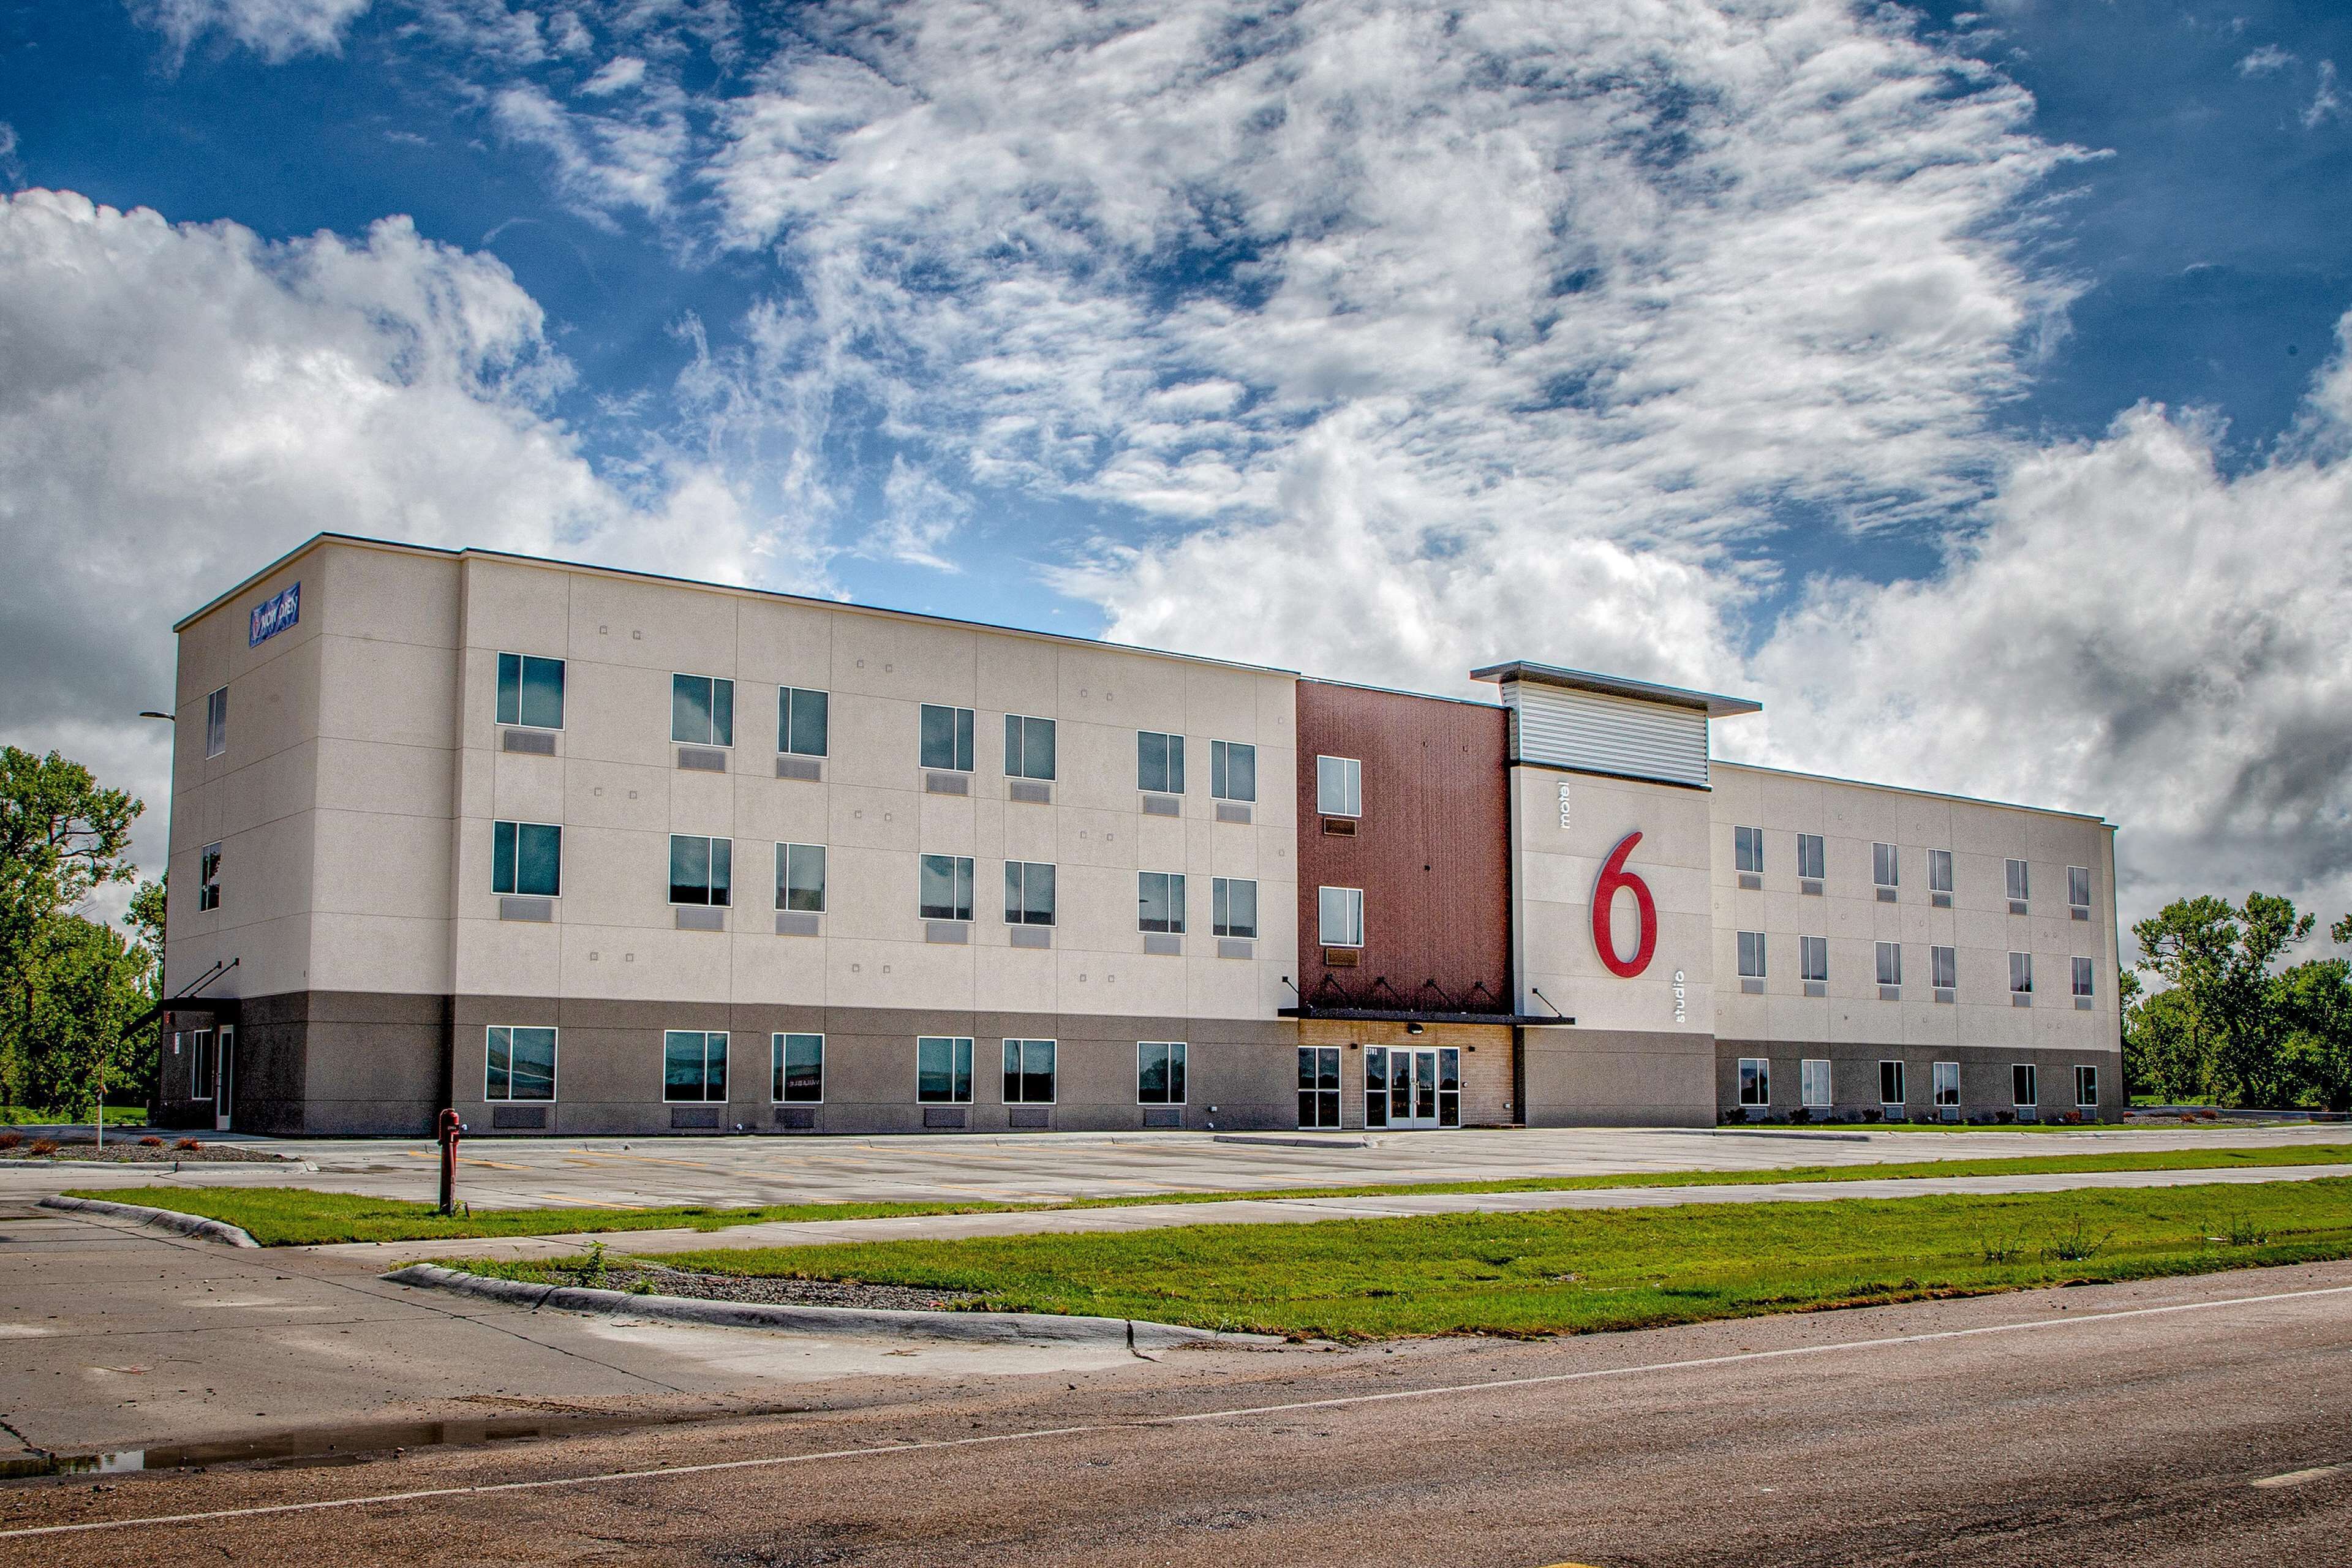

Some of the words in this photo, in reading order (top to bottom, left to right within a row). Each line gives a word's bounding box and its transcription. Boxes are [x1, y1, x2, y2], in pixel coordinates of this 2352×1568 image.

[279, 596, 298, 620] OPEN
[1558, 782, 1570, 829] motel
[1589, 831, 1657, 978] 6
[1672, 970, 1686, 1023] studio
